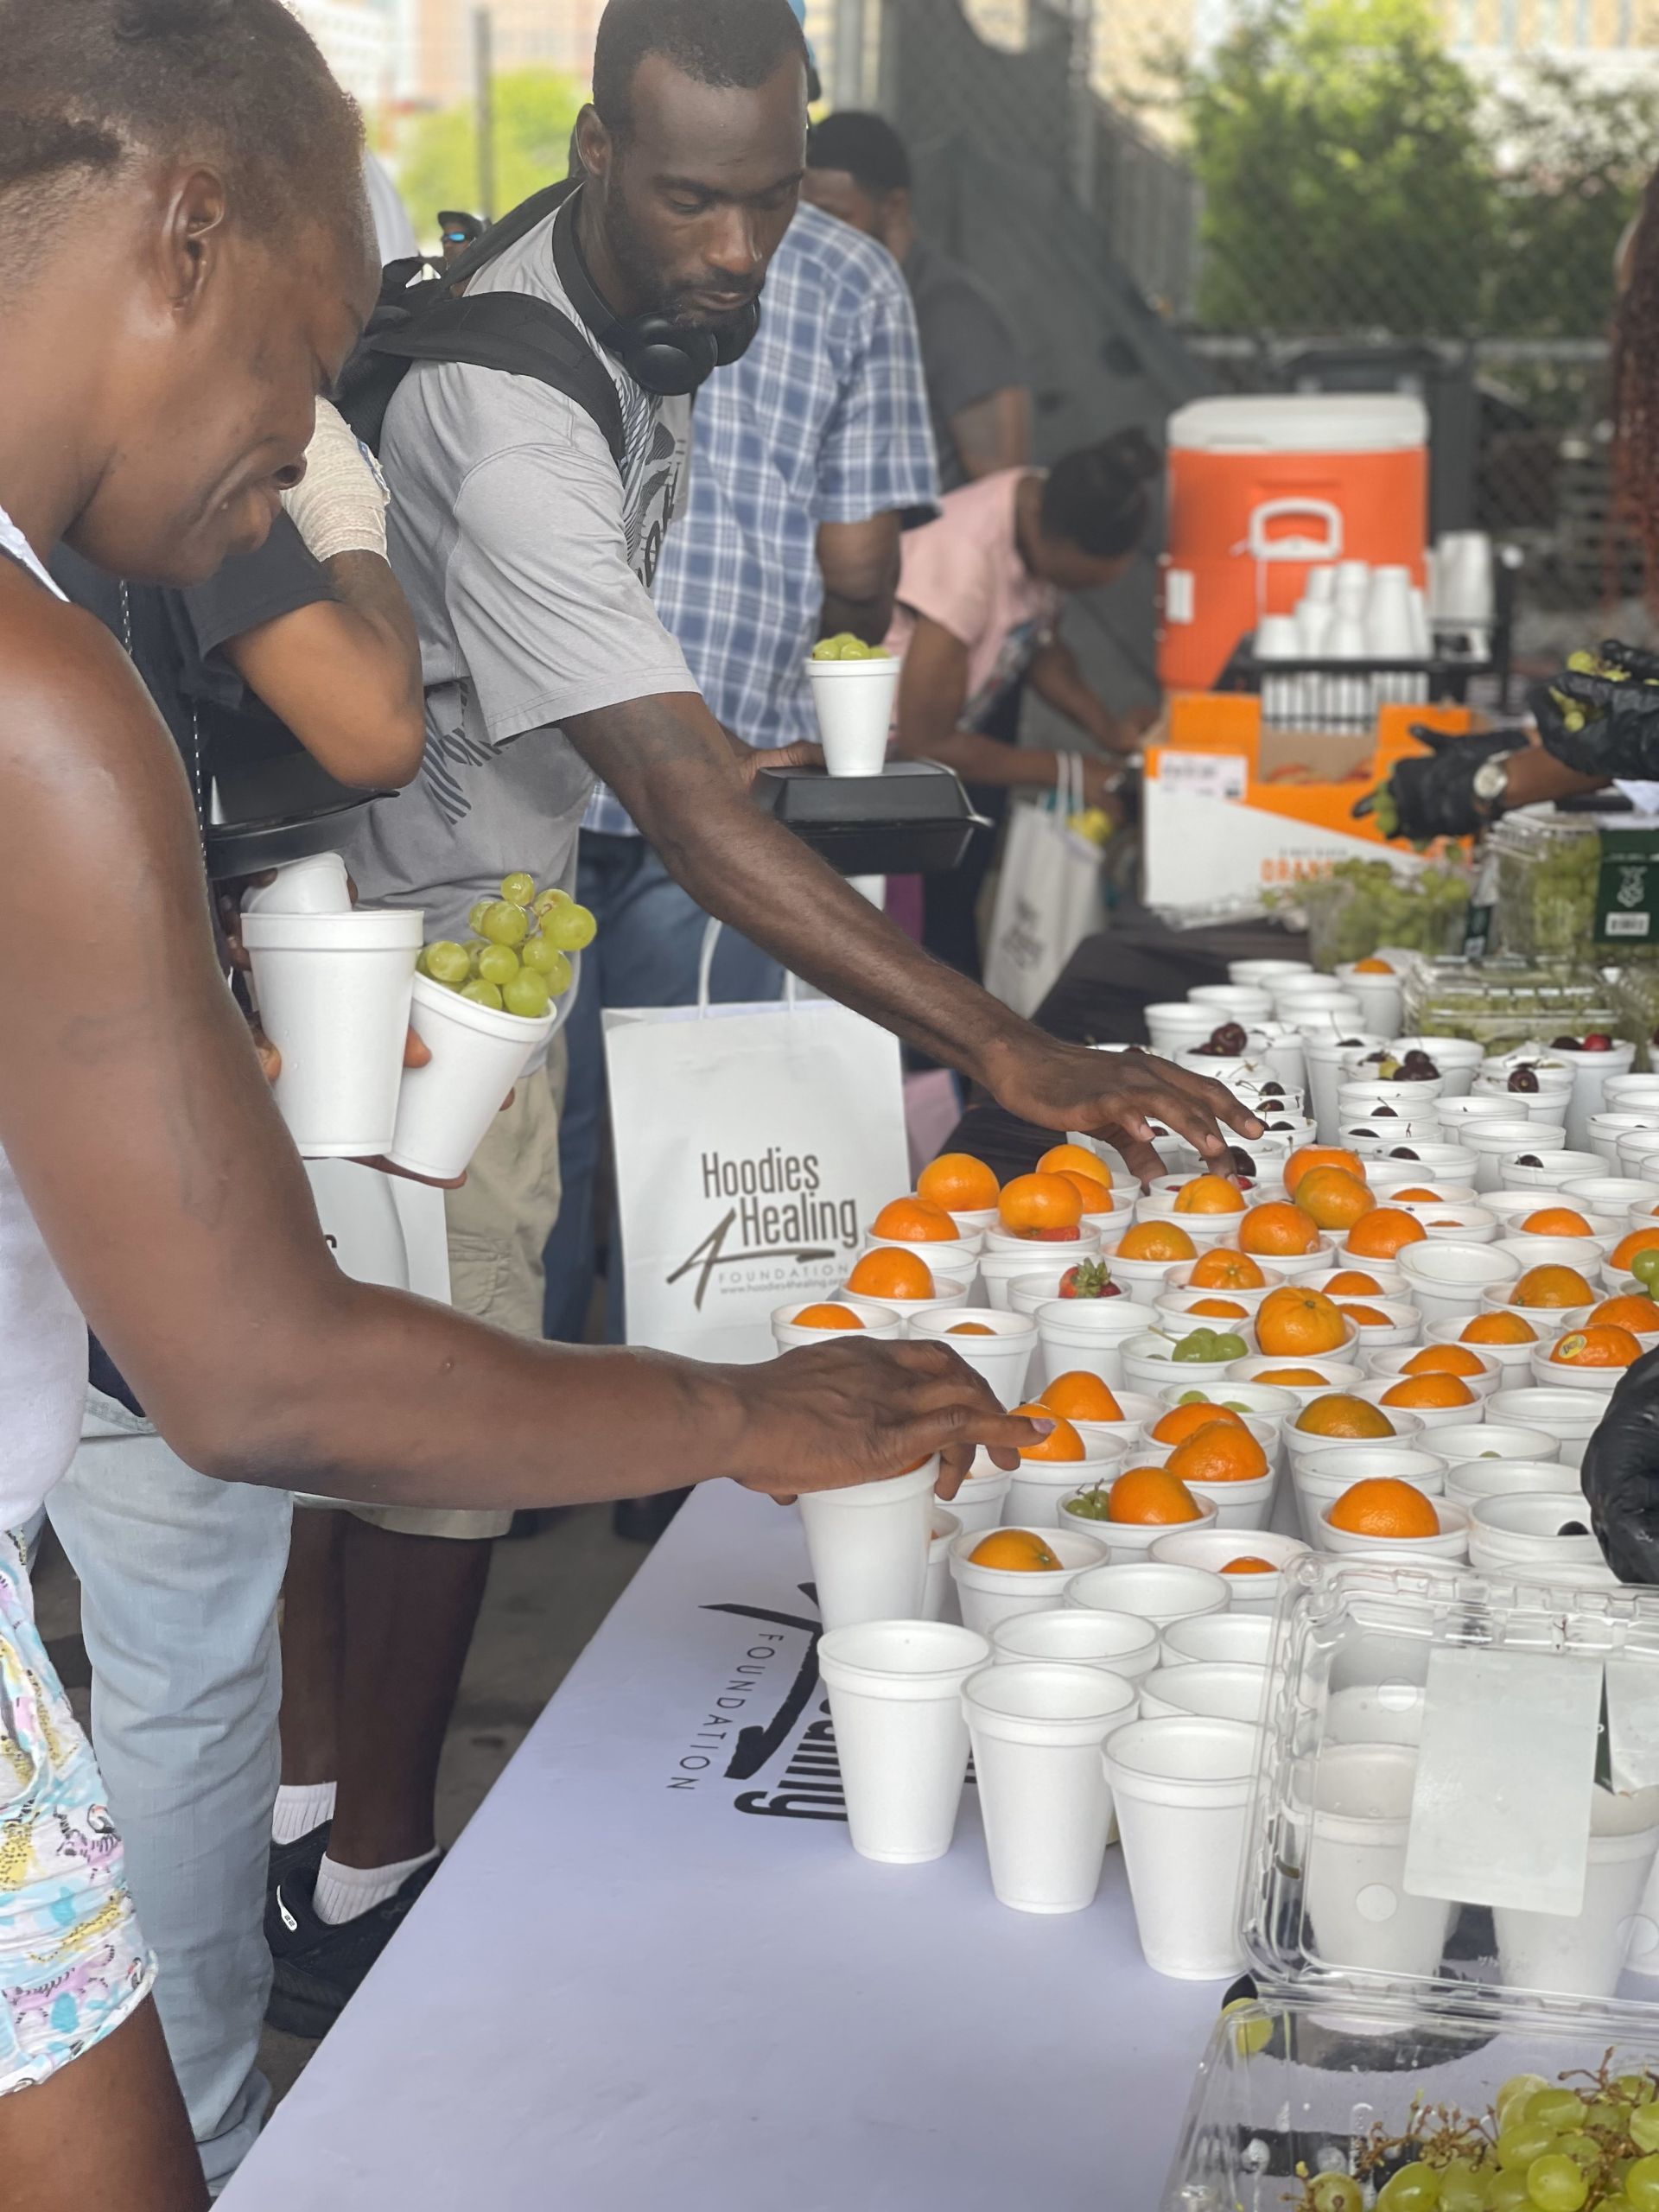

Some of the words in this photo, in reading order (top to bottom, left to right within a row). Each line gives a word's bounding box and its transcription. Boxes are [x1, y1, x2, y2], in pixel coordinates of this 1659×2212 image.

[702, 1147, 820, 1198] Hoodies
[740, 1192, 858, 1249] Healing
[718, 1264, 848, 1284] FOUNDATION
[666, 1633, 784, 1789] FOUNDATION
